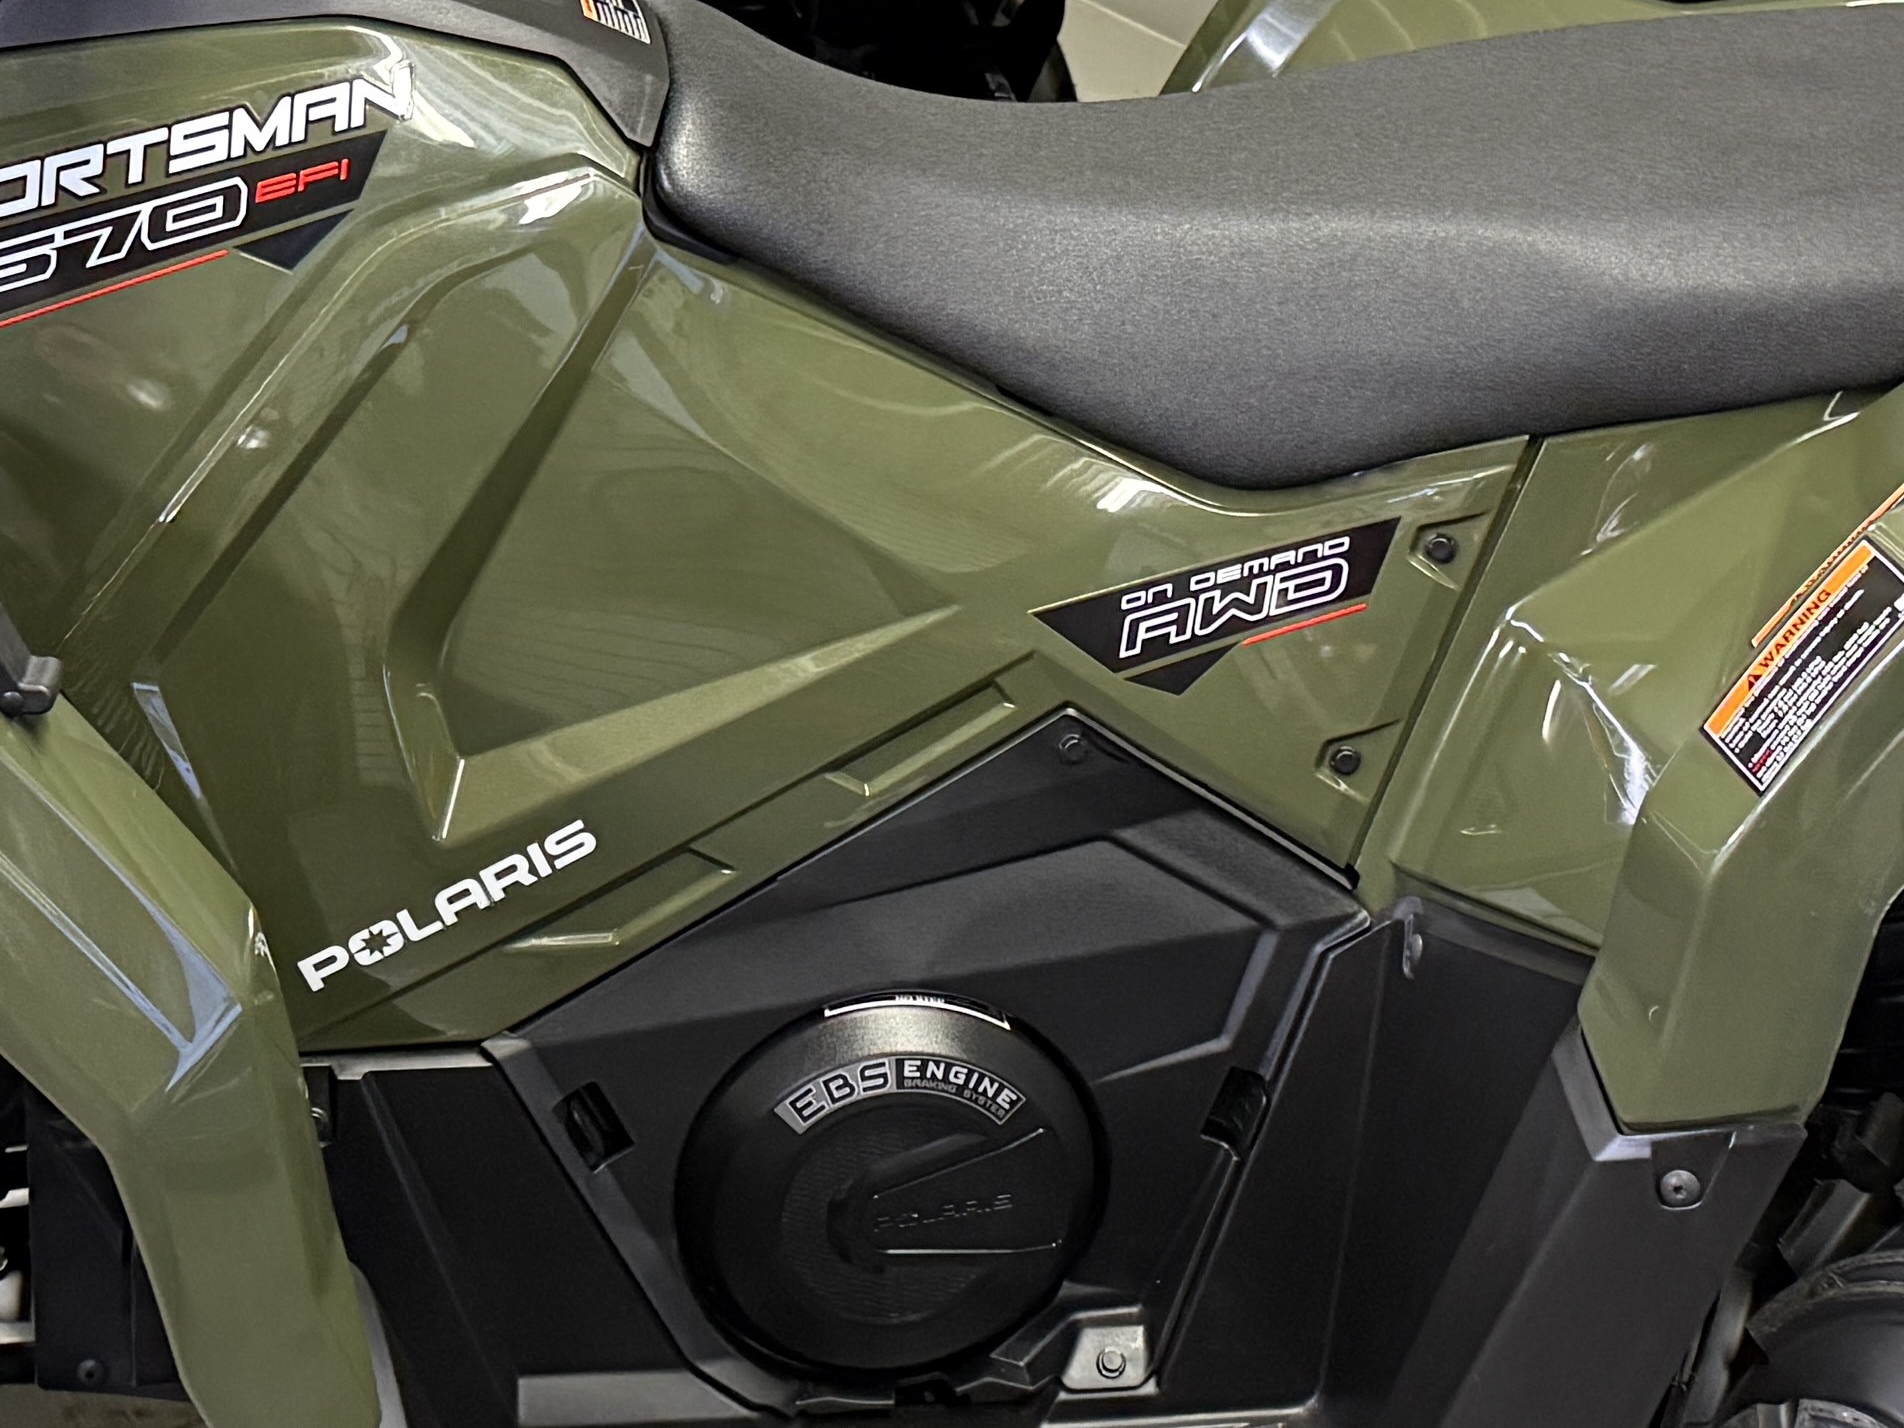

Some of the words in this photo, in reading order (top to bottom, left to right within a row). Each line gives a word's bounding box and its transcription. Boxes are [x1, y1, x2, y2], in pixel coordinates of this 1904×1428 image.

[254, 158, 349, 204] EFI
[1118, 561, 1350, 658] AWD
[1120, 587, 1174, 610] ON
[1187, 535, 1350, 596] DEMAND
[1759, 588, 1833, 670] WARNING
[297, 819, 598, 992] POLARIS
[788, 1058, 891, 1124] EBS
[903, 1059, 1018, 1110] ENGINE
[903, 1078, 958, 1095] BRAKING
[963, 1089, 1006, 1119] SYSTEM
